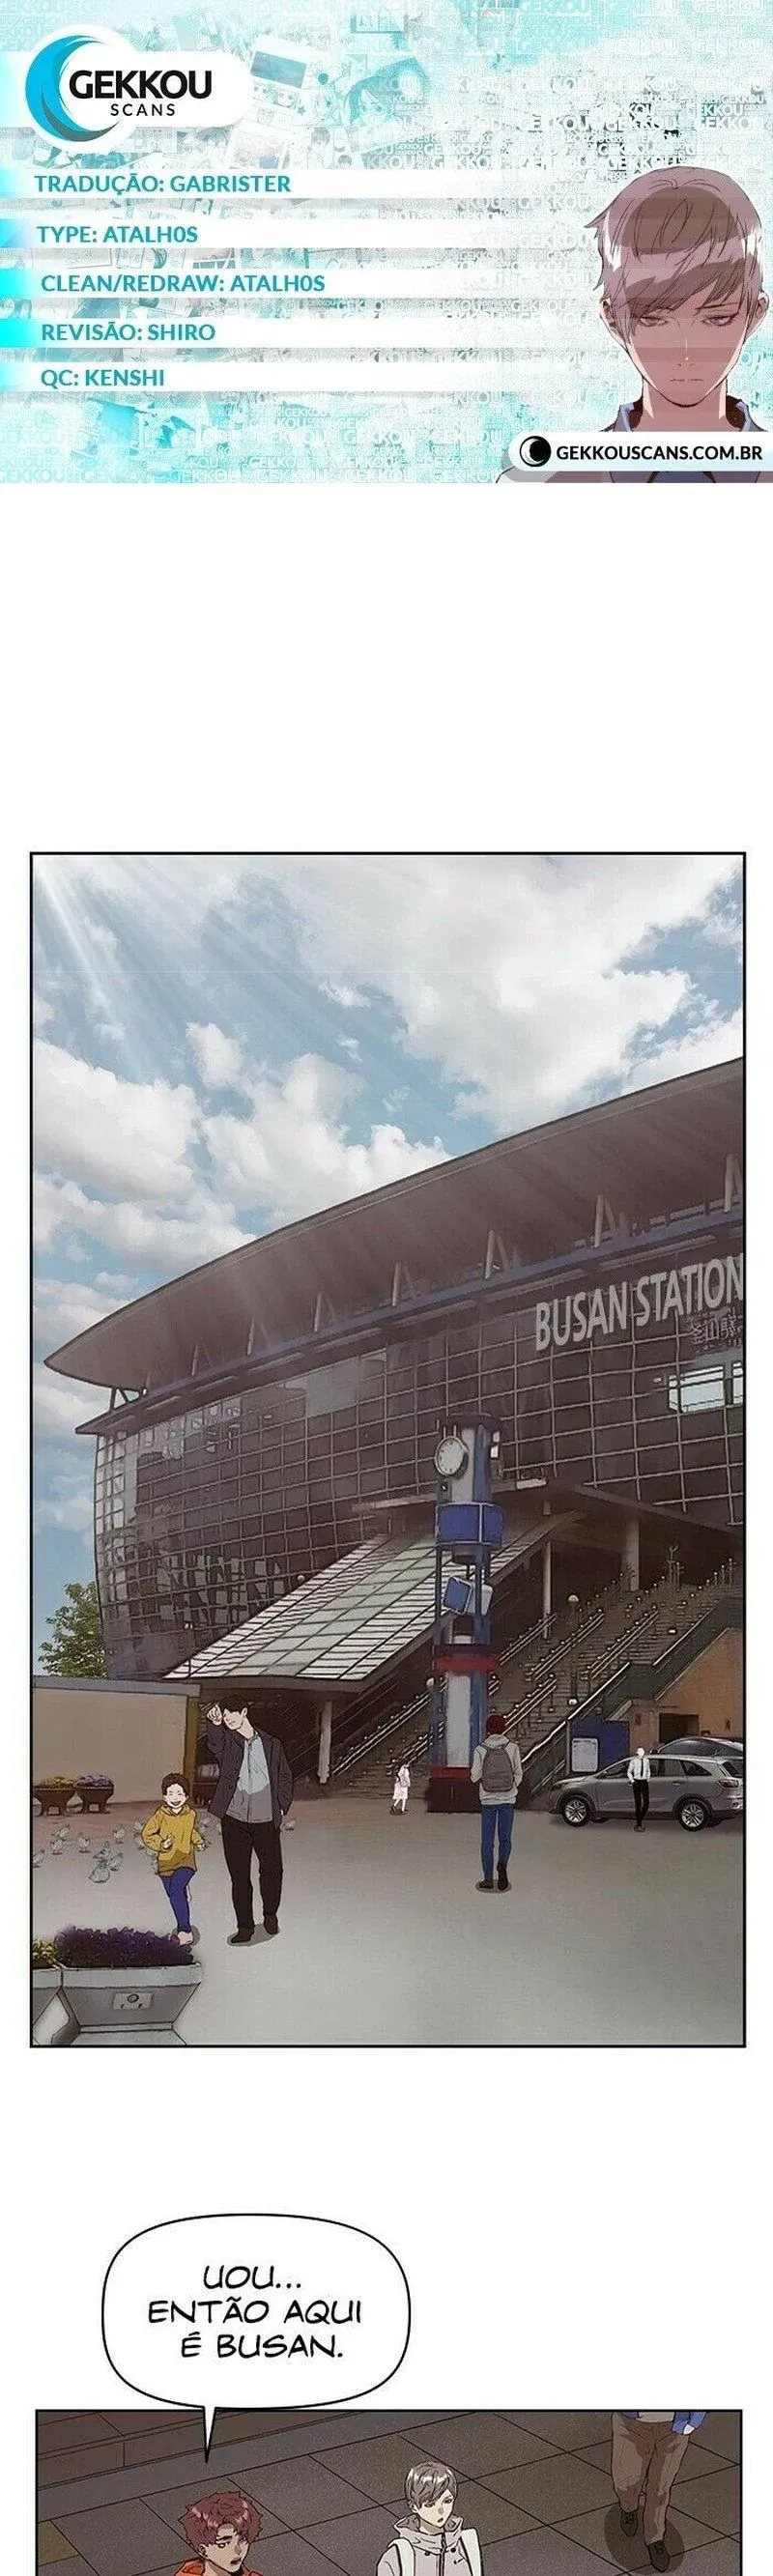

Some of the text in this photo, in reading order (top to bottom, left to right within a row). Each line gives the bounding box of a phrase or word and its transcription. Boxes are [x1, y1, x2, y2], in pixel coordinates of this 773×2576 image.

[536, 1253, 743, 1351] BUSAN STATION
[203, 2265, 301, 2290] UOU...
[148, 2296, 361, 2325] ENTÃO AQUI
[181, 2332, 343, 2359] É BUSAN.
